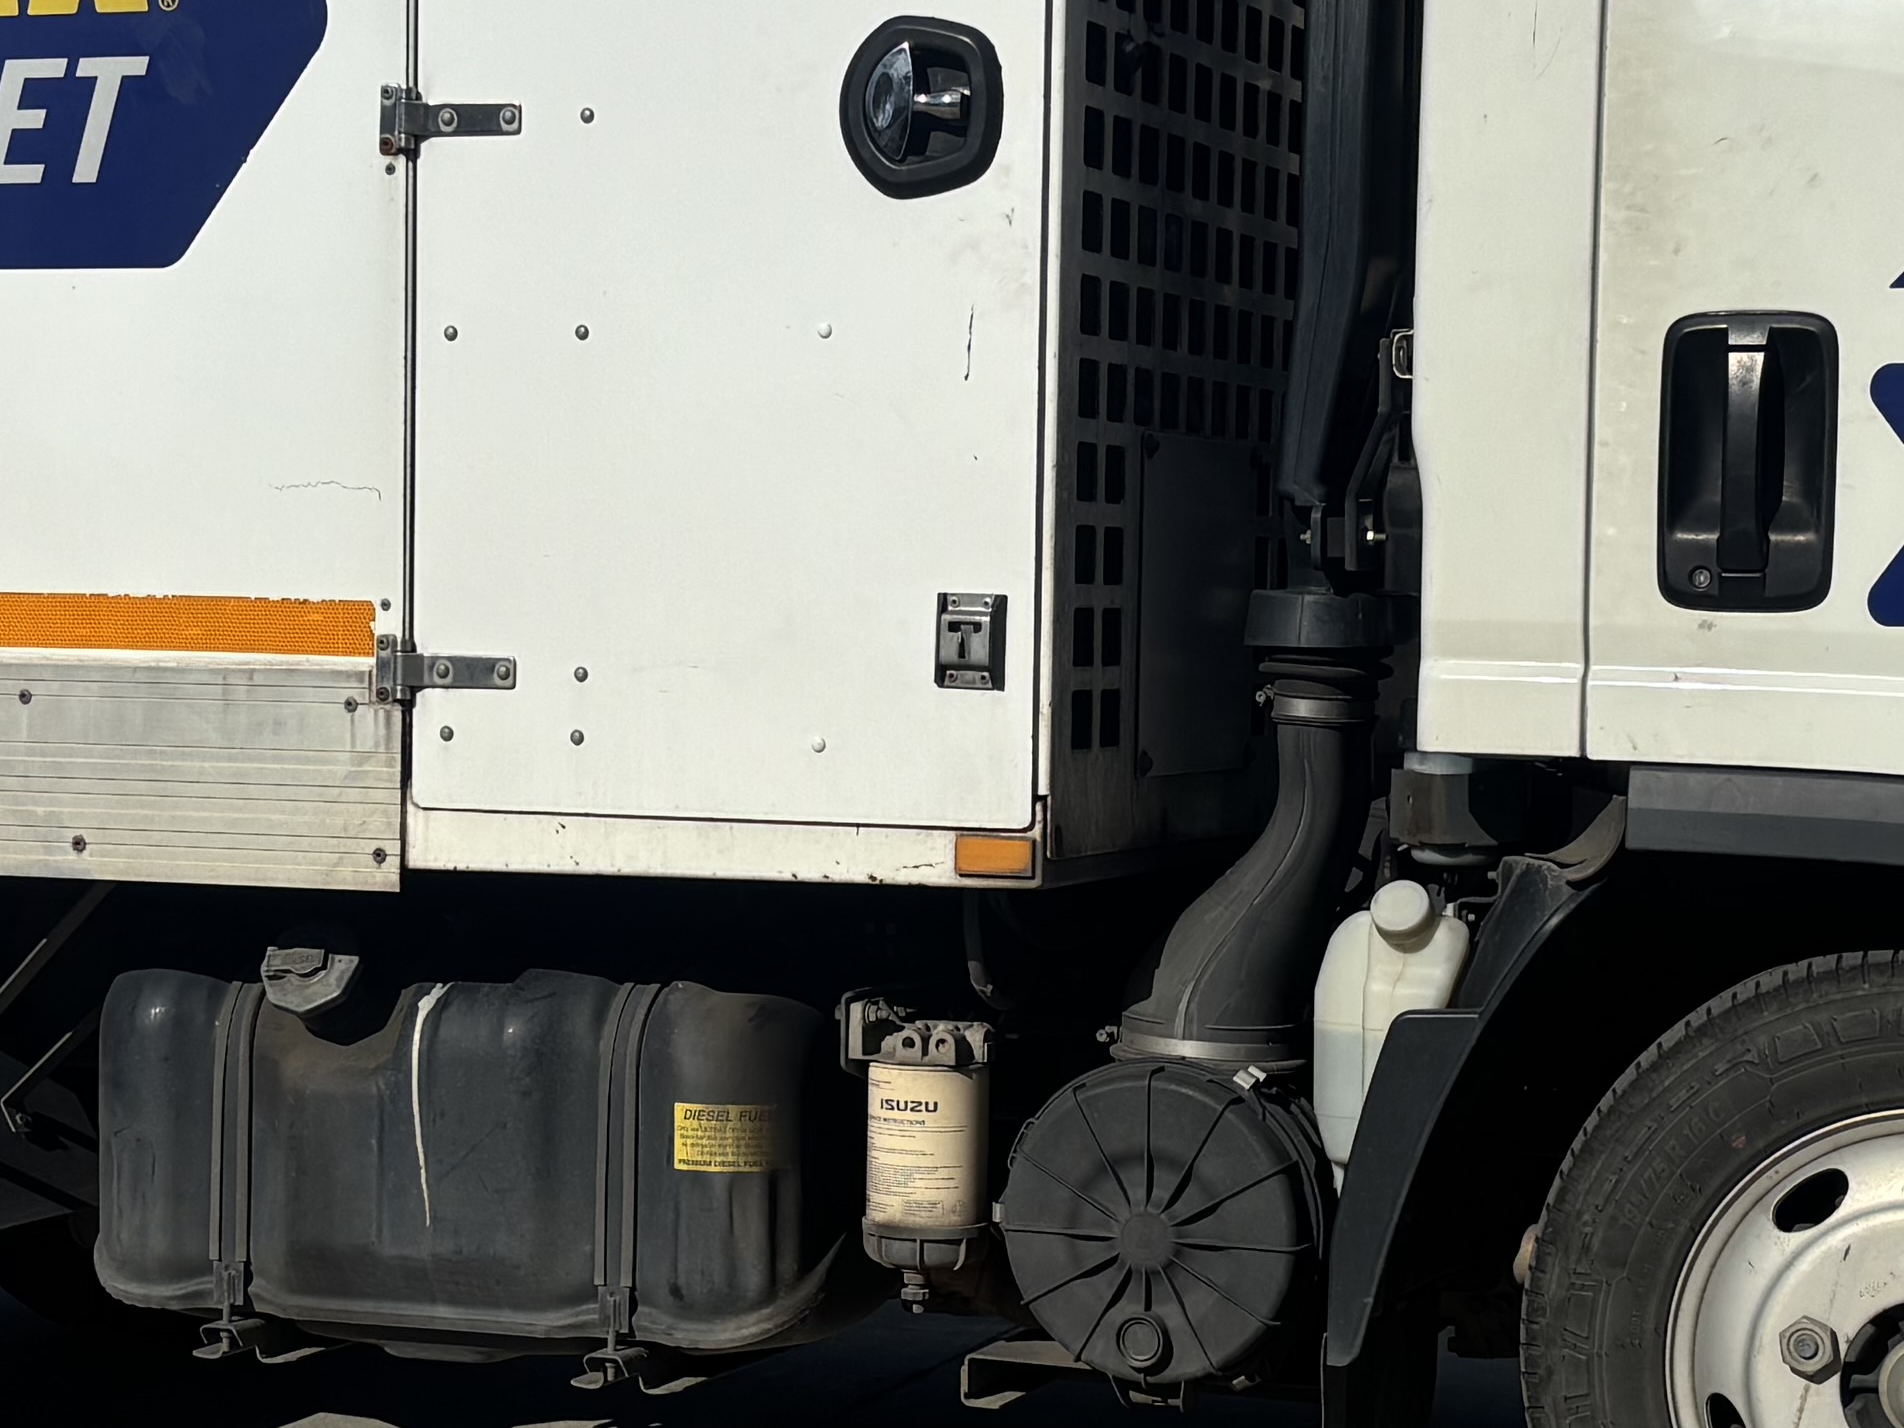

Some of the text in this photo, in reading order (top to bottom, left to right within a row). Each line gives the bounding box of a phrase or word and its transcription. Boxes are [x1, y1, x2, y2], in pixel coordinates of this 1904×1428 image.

[880, 1098, 939, 1113] ISUZU
[684, 1108, 772, 1123] DIESEL FUE
